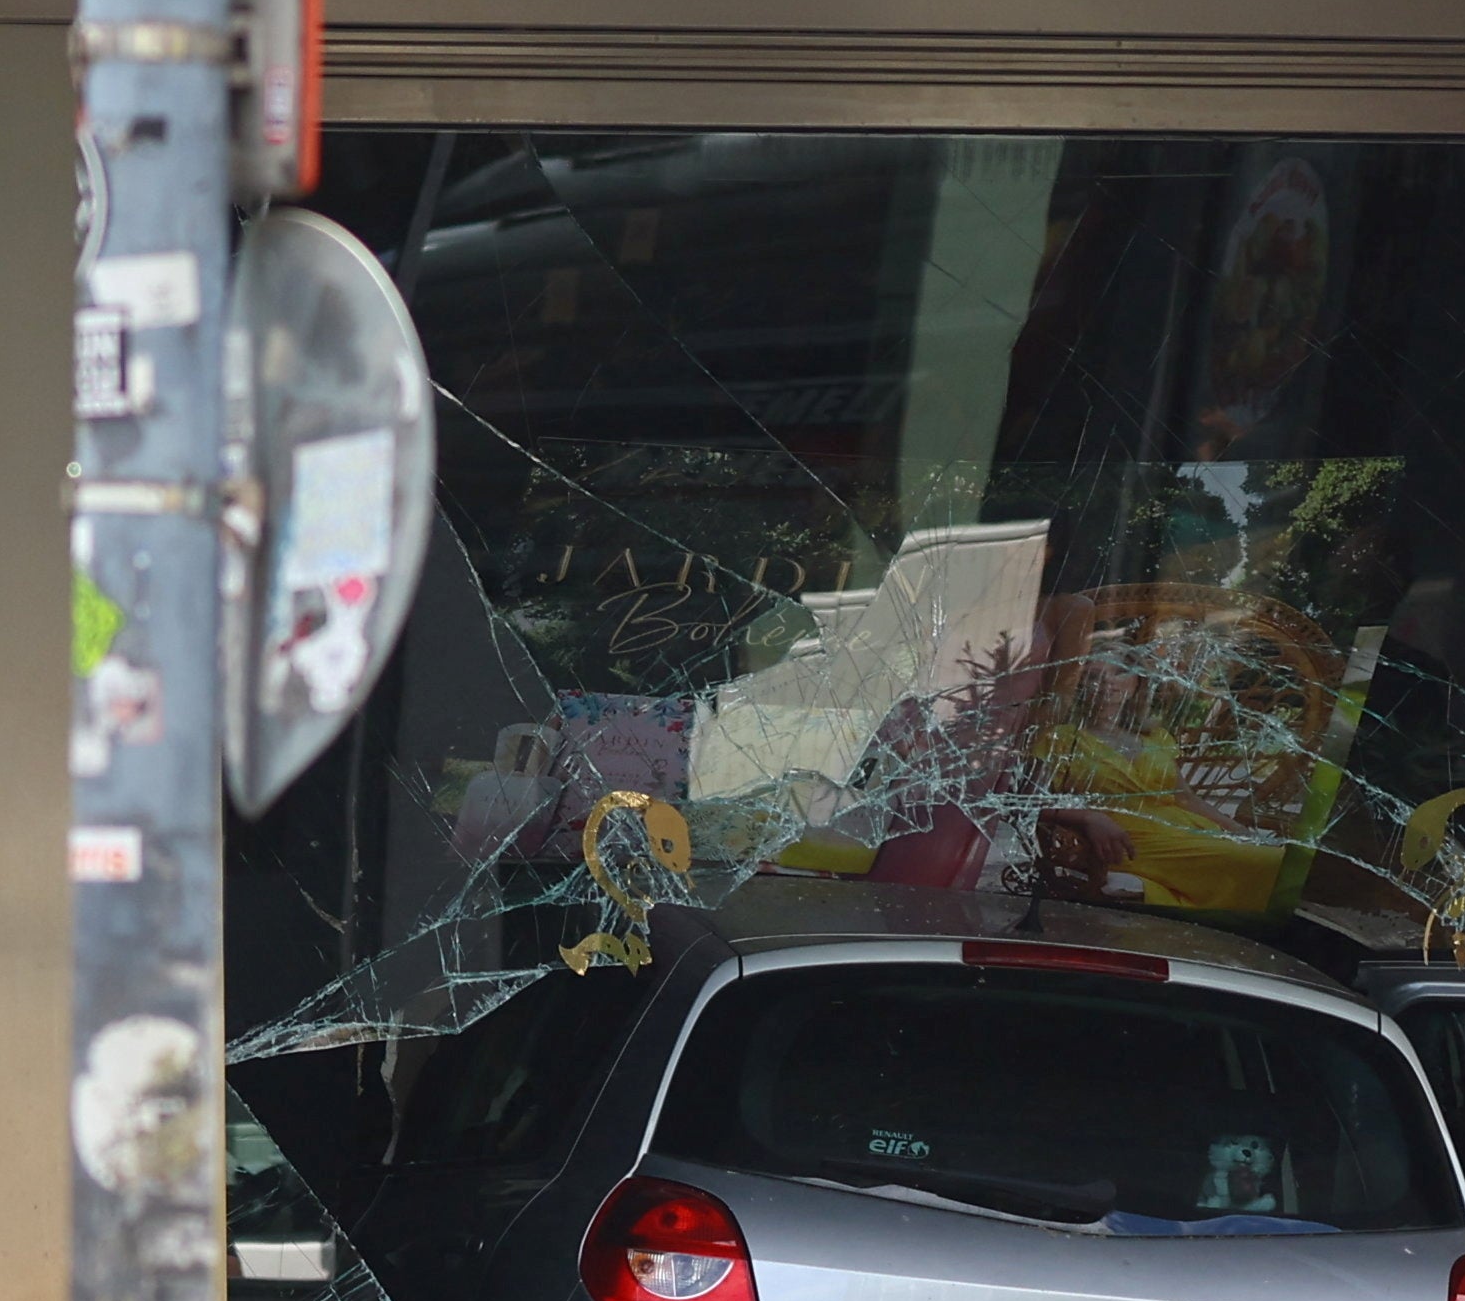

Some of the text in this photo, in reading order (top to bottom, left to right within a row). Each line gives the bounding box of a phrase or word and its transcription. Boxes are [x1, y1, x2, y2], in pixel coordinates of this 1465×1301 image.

[535, 545, 930, 603] JARDIN
[872, 1129, 913, 1140] RENAULT
[869, 1139, 908, 1154] elf
